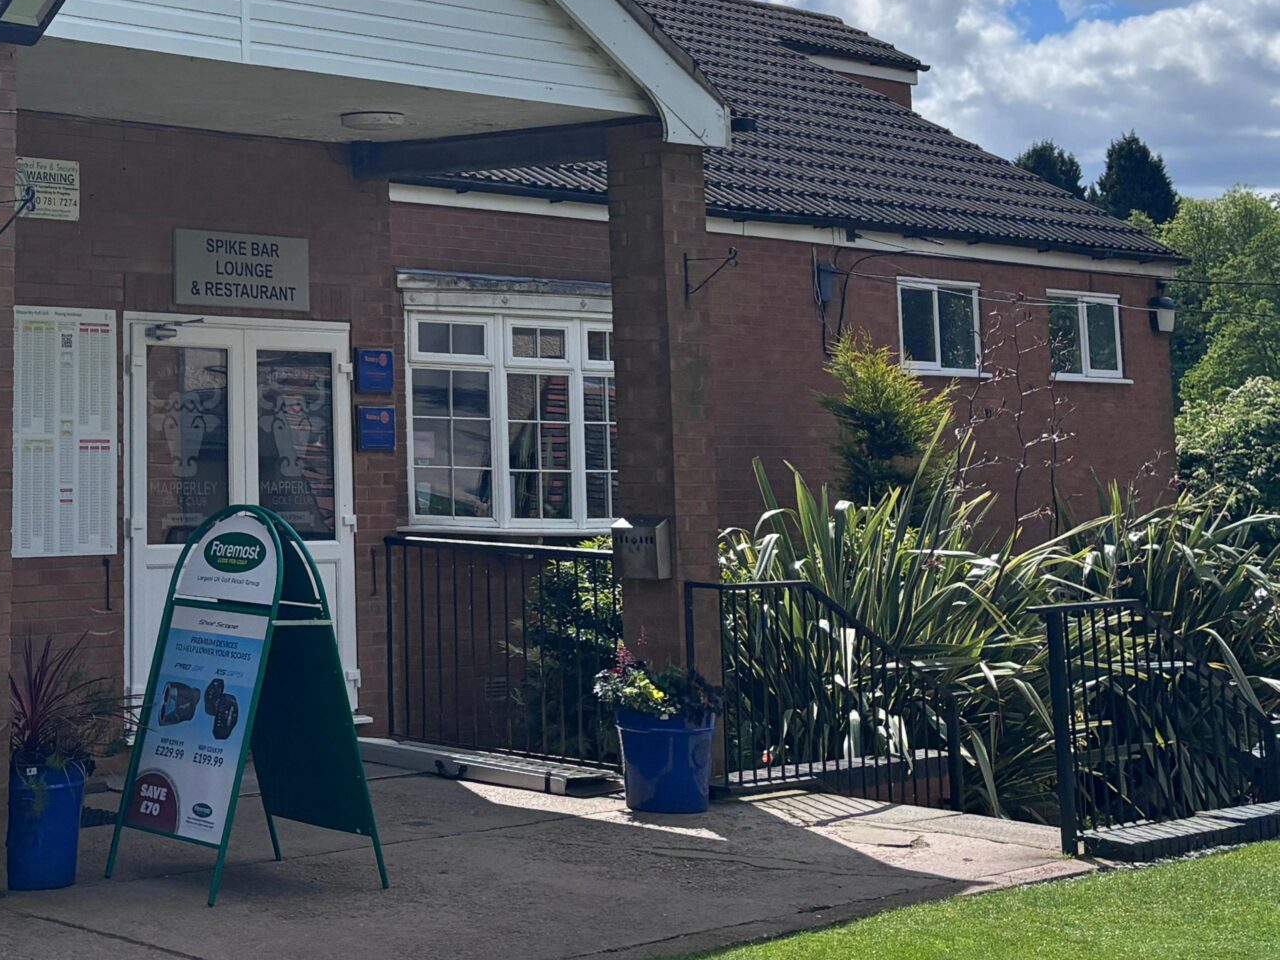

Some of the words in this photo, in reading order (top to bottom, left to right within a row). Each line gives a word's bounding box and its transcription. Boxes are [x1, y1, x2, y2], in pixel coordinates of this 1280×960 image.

[26, 170, 75, 184] WARNING
[43, 196, 56, 206] 781
[60, 198, 78, 207] 7274
[206, 238, 247, 256] SPIKE
[251, 242, 280, 258] BAR
[216, 260, 273, 279] LOUNGE
[190, 280, 201, 296] &
[205, 281, 296, 302] RESTAURANT
[150, 481, 218, 495] MAPPERLEY
[210, 540, 261, 560] Foremost
[230, 651, 252, 661] SCORES
[154, 745, 185, 760] £229.99
[192, 752, 224, 768] £199.99
[140, 783, 167, 801] SAVE
[139, 800, 160, 816] £70
